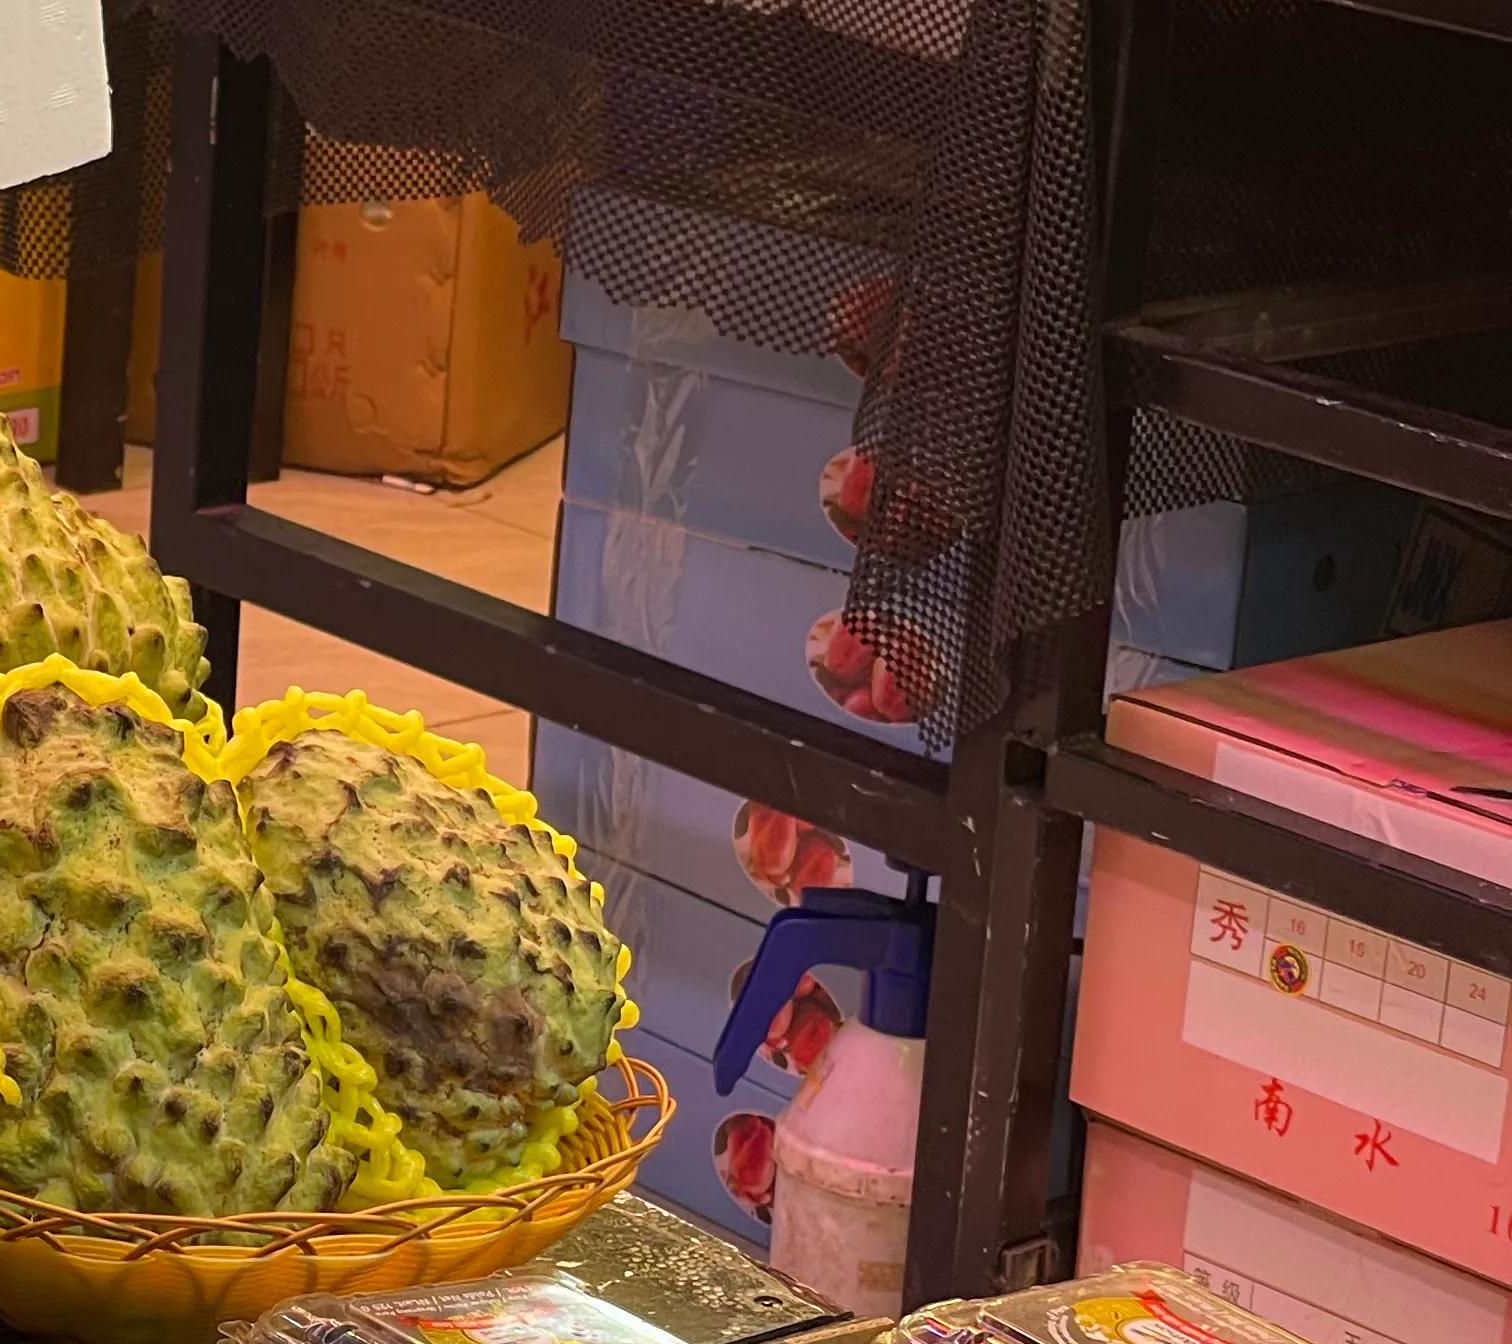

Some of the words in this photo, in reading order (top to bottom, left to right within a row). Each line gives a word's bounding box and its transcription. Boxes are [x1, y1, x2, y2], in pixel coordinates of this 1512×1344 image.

[1209, 898, 1249, 951] 秀
[1407, 960, 1426, 980] 20
[1469, 982, 1487, 1002] 24
